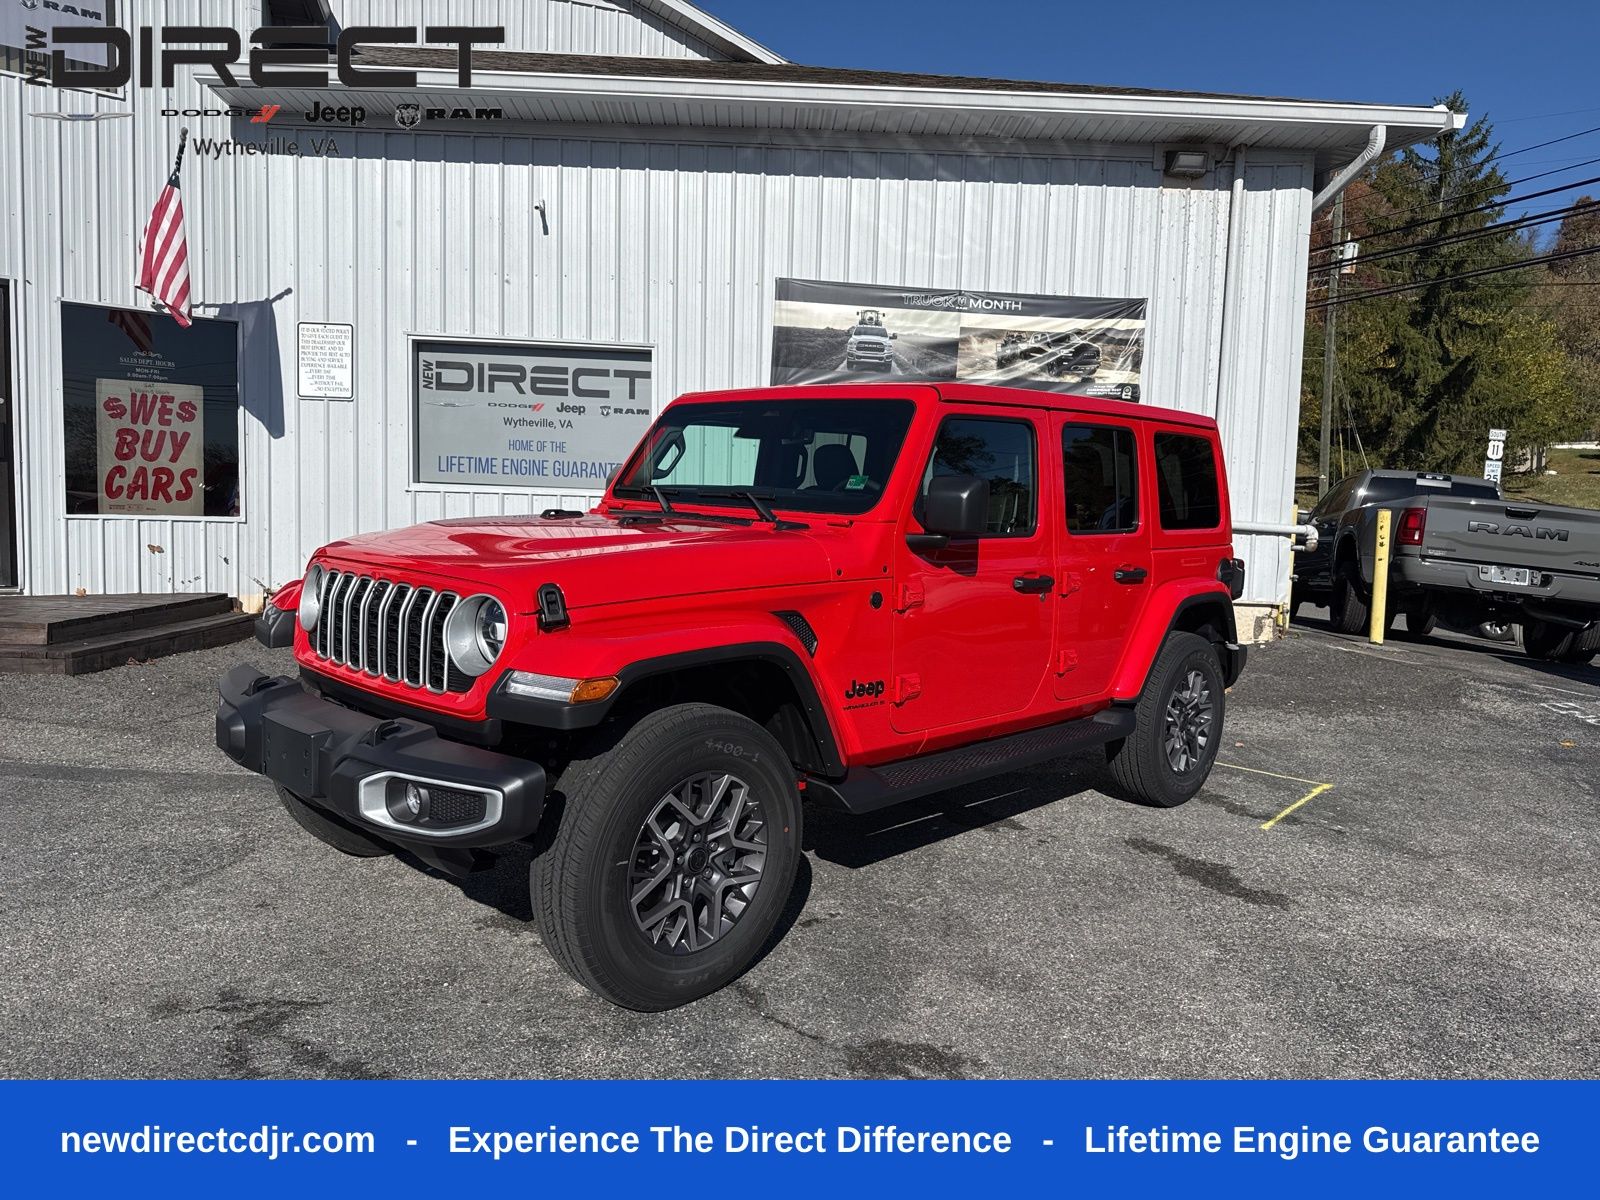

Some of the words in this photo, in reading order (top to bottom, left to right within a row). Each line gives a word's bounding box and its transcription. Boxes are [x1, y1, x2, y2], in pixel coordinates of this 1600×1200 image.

[43, 1, 102, 21] RAM
[902, 293, 955, 308] TRUCK
[969, 298, 1022, 311] MONTH
[422, 359, 434, 390] NEW
[435, 360, 652, 400] DIRECT
[556, 402, 586, 415] Jeep
[613, 407, 650, 416] RAM
[503, 416, 557, 429] Wytheville,
[559, 419, 573, 429] VA
[1490, 430, 1506, 438] SOUTH
[114, 428, 190, 463] BUY
[508, 439, 534, 452] HOME
[536, 440, 548, 453] OF
[550, 441, 567, 453] THE
[1491, 444, 1500, 456] 11
[438, 456, 498, 475] LIFETIME
[502, 458, 549, 477] ENGINE
[553, 460, 623, 479] GUARANT
[104, 465, 198, 503] CARS
[1467, 520, 1570, 542] RAM
[845, 680, 885, 699] Jeep
